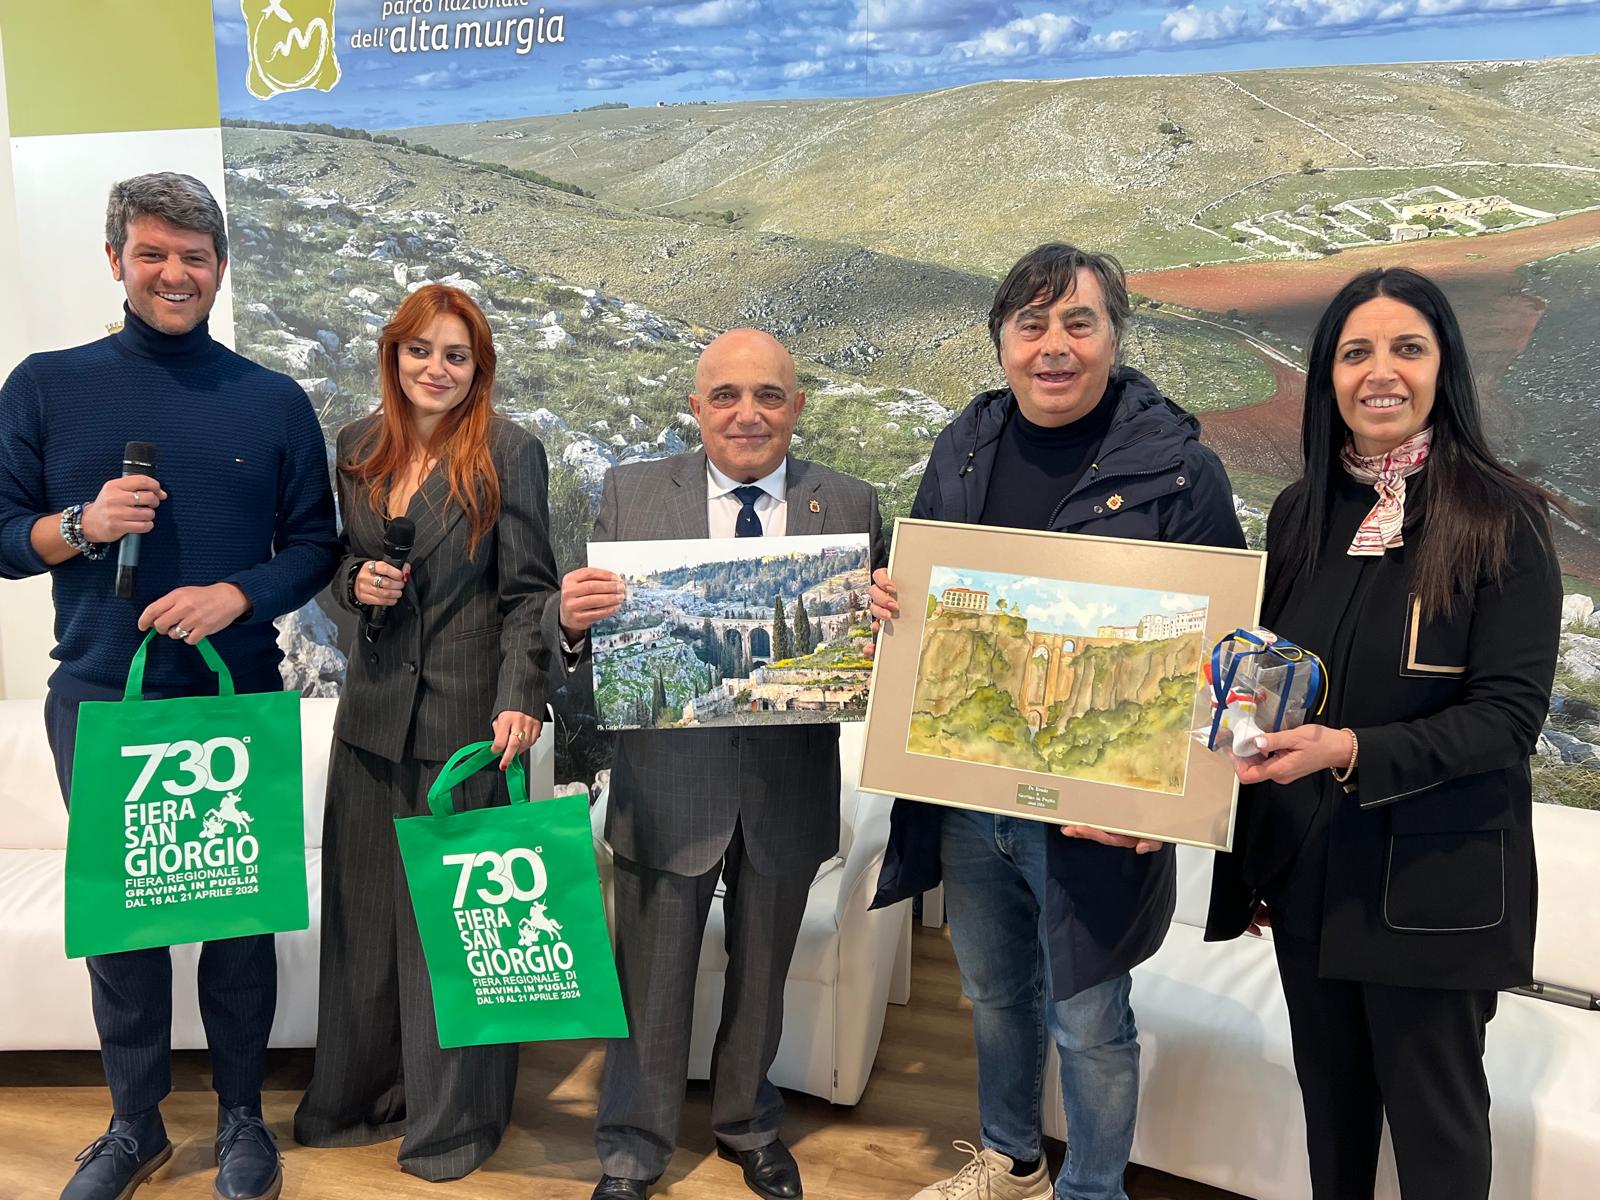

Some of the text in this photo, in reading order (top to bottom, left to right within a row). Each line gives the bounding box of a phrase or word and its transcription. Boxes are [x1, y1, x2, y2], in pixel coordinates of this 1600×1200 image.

[381, 0, 433, 20] parco
[454, 8, 565, 54] murgia
[125, 798, 196, 827] FIERA
[125, 822, 176, 848] SAN
[125, 835, 259, 876] GIORGIO
[126, 865, 258, 888] FIERA REGIONALE DI
[126, 876, 258, 897] GRAVINA IN PUGLIA
[126, 885, 258, 908] DAL 18 AL 21 APRILE 2024
[454, 907, 511, 930] FIERA
[461, 929, 501, 950] SAN
[467, 942, 574, 976] GIORGIO
[473, 971, 576, 987] FIERA REGIONALE DI
[476, 986, 521, 996] GRAVINA
[538, 981, 578, 992] PUGLIA
[477, 996, 494, 1005] DAL
[519, 994, 528, 1002] 21
[529, 992, 559, 1001] APRILE
[561, 990, 580, 999] 2024
